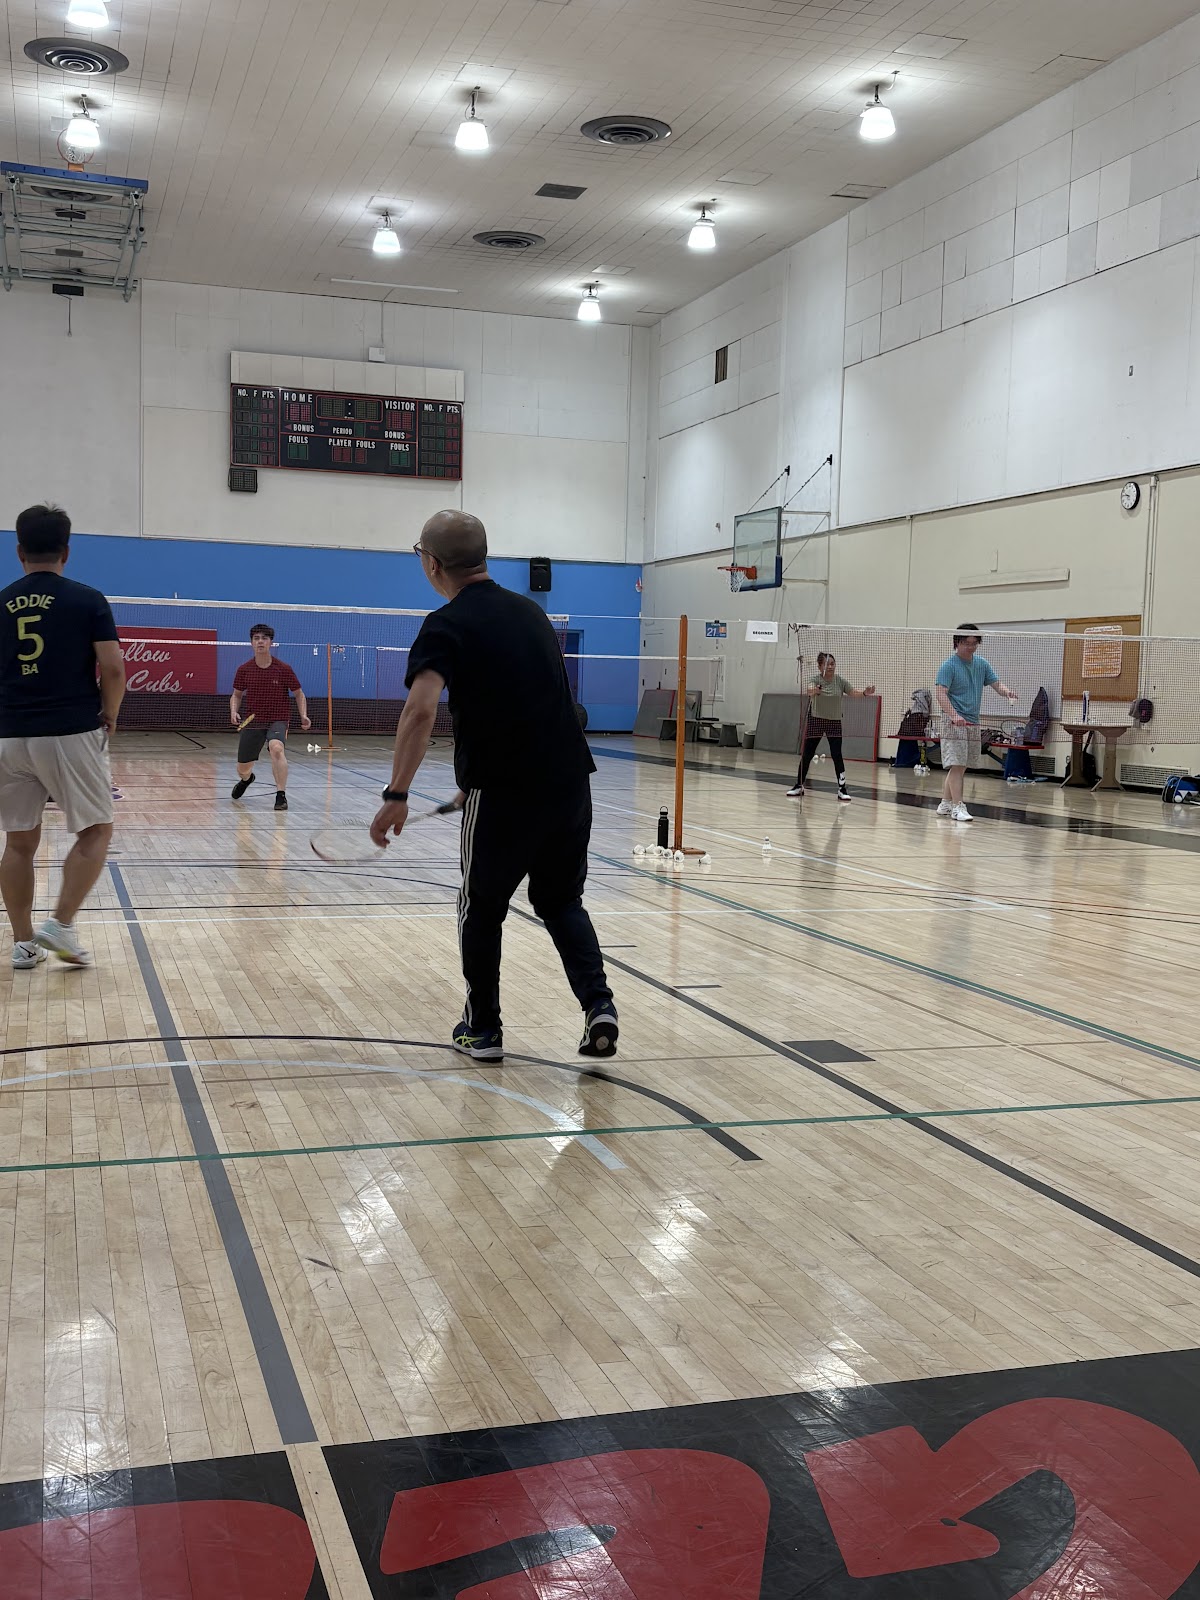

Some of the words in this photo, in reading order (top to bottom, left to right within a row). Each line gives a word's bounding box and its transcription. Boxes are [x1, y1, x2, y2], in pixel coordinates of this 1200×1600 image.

[237, 388, 249, 397] NO.
[253, 389, 258, 398] F
[261, 390, 276, 399] PTS.
[283, 392, 313, 403] HOME
[384, 400, 416, 411] VISITOR
[423, 403, 435, 412] NO.
[438, 404, 443, 412] F
[446, 406, 460, 414] PTS.
[293, 423, 315, 433] BONUS
[332, 426, 353, 435] PERIOD
[288, 435, 309, 444] FOULS
[384, 430, 405, 440] BONUS
[328, 438, 352, 447] PLAYER
[355, 440, 376, 449] FOULS
[390, 442, 410, 452] FOULS
[5, 593, 56, 614] EDDIE
[16, 614, 45, 662] 5
[119, 641, 171, 663] ollow
[21, 663, 39, 676] BA
